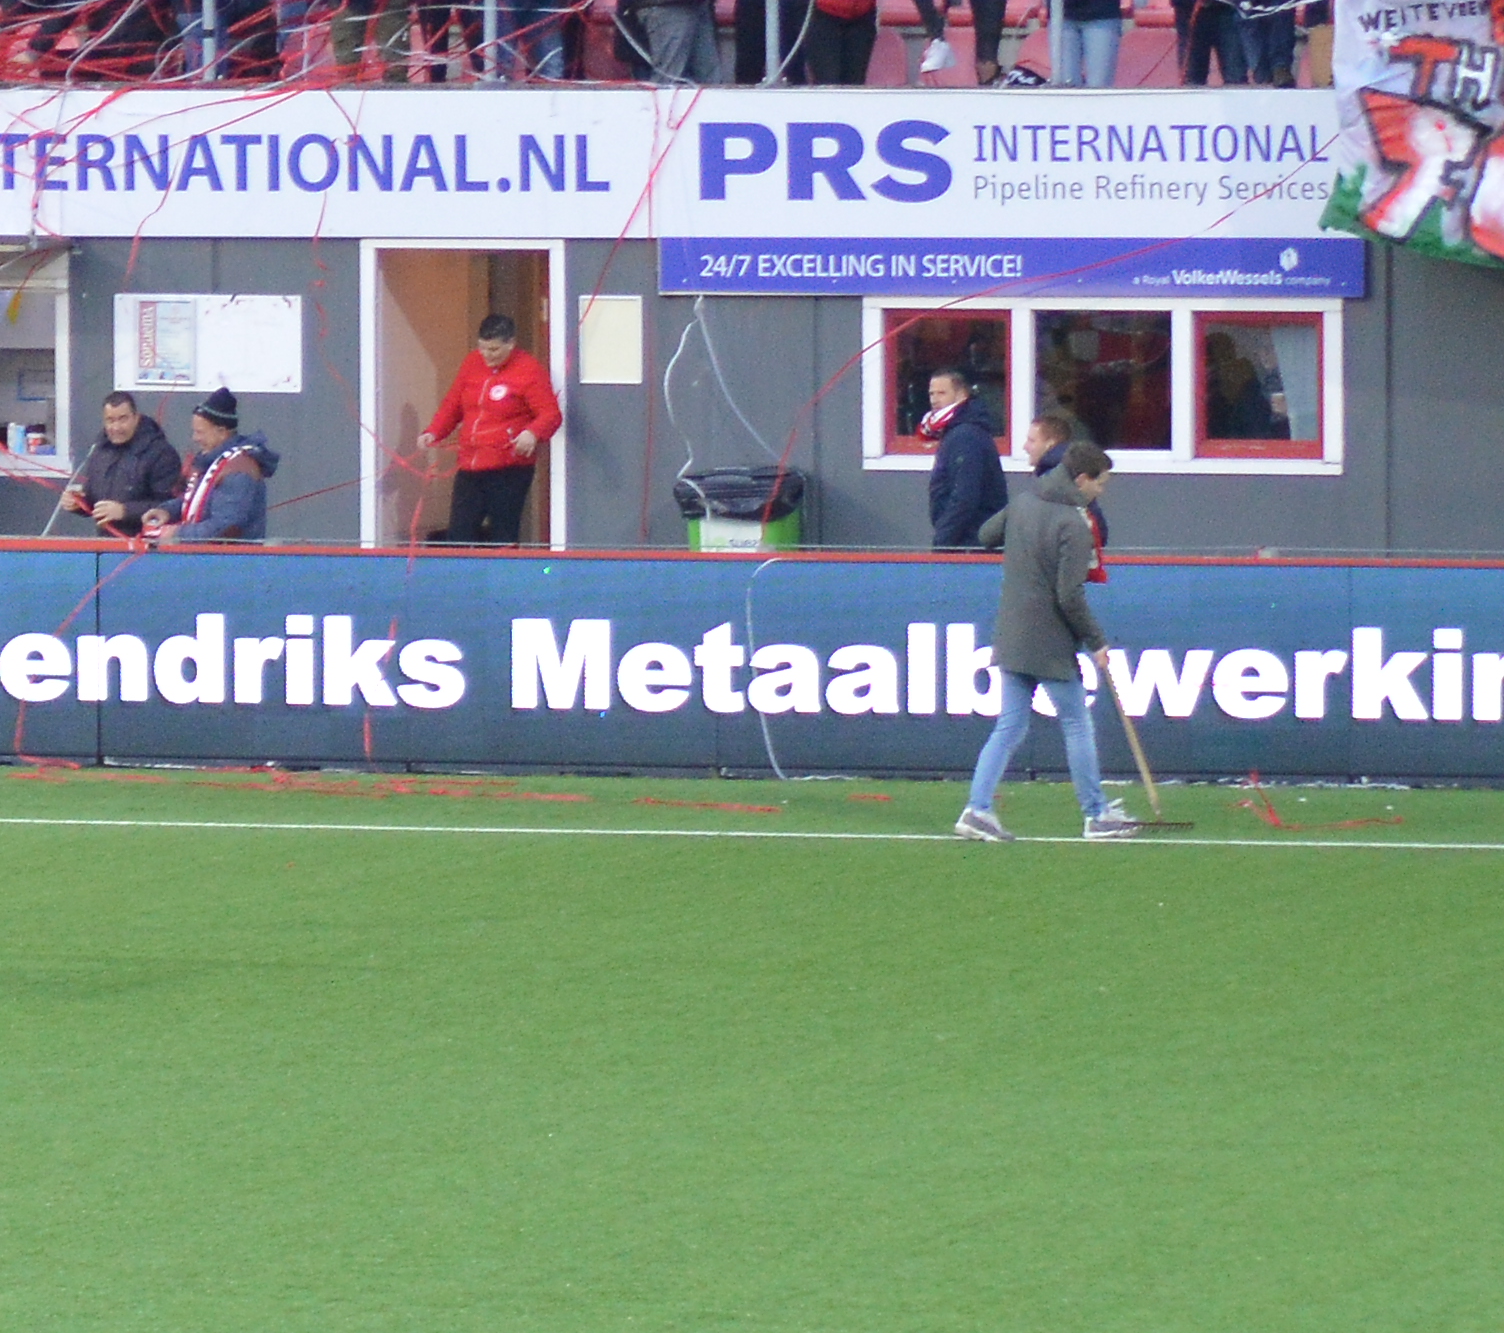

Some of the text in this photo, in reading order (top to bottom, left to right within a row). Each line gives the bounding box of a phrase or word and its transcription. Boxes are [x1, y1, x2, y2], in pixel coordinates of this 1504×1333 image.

[699, 120, 1329, 203] PRS INTERNATIONAL
[973, 175, 1330, 206] Pipeline Refinery Services
[700, 253, 1023, 280] 24/7 EXCELLING IN SERVICE!
[1172, 268, 1283, 287] VolkerWessels
[513, 618, 1504, 720] Metaalbwerki
